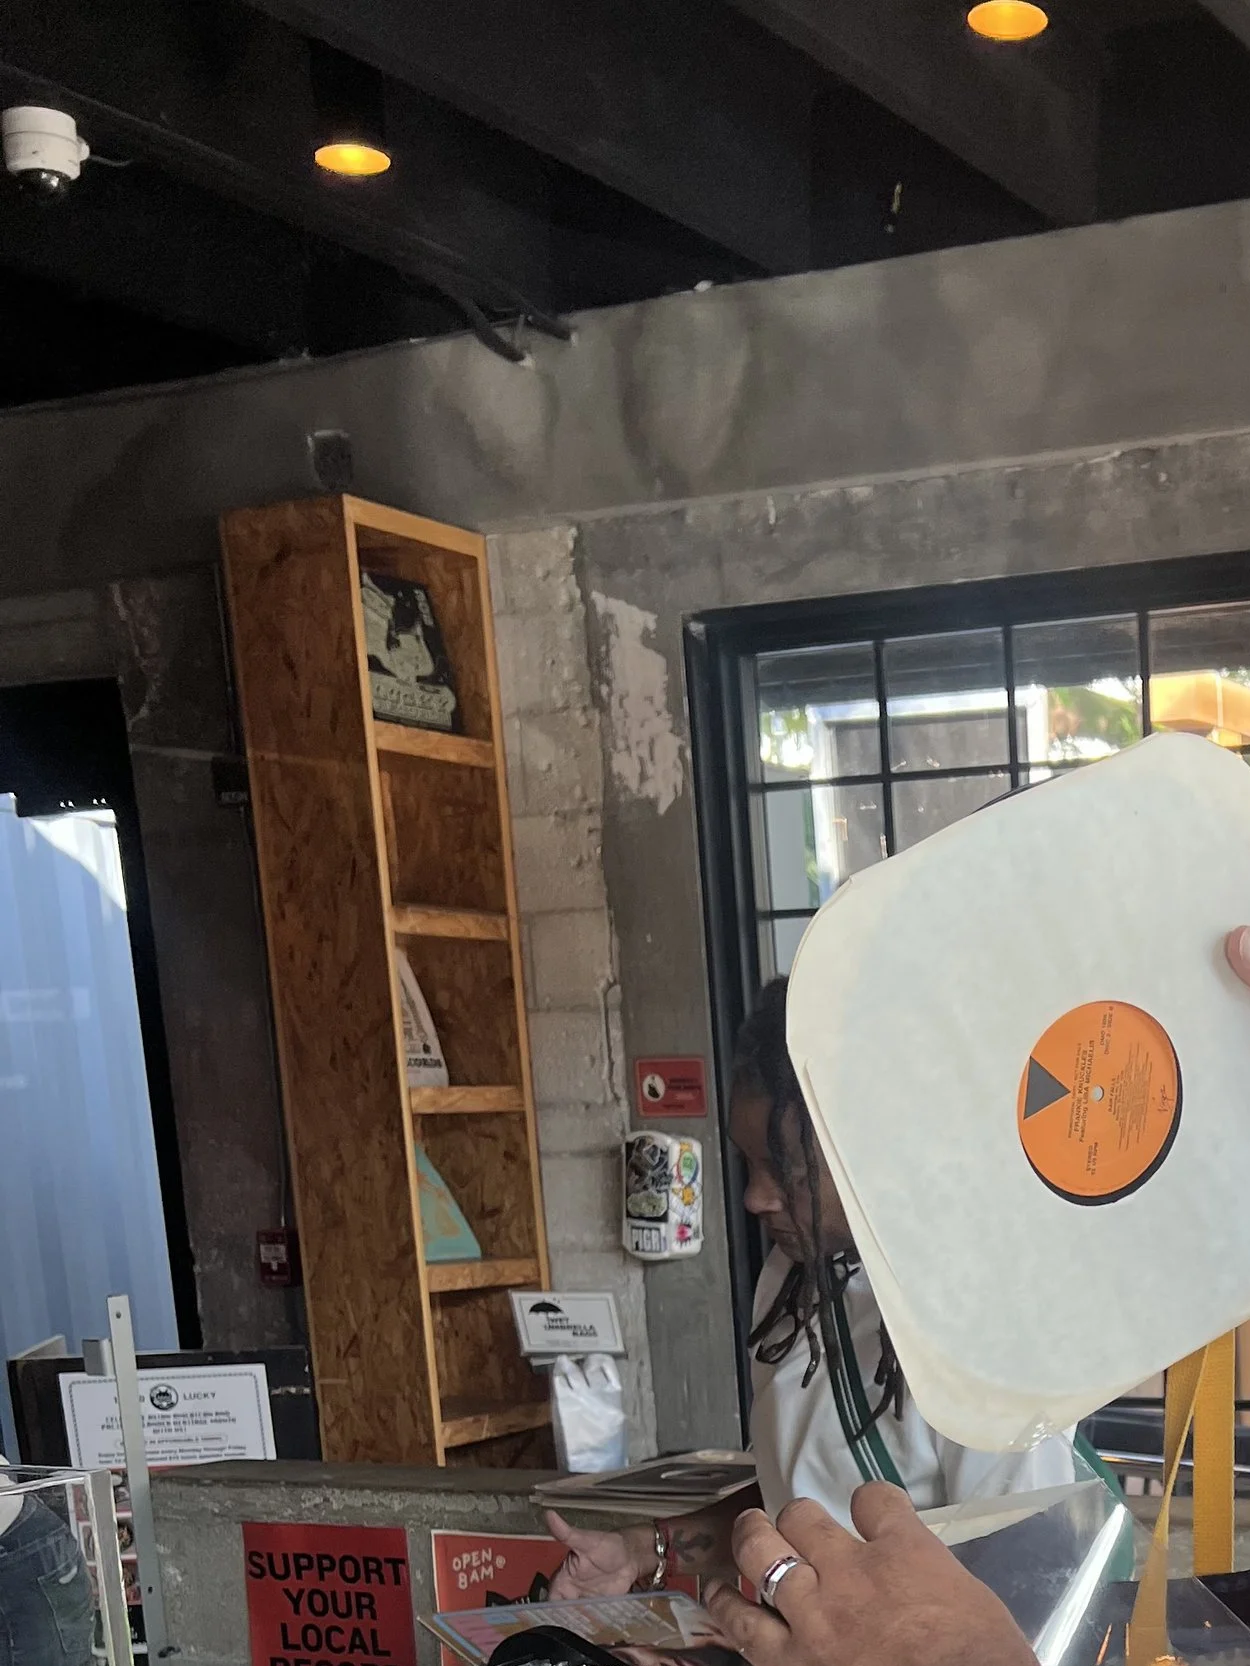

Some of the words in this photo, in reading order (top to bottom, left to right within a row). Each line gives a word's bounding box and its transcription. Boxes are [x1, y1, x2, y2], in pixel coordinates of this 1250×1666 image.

[183, 1392, 217, 1401] LUCKY
[248, 1551, 406, 1586] SUPPORT
[452, 1548, 493, 1572] OPEN
[458, 1566, 494, 1590] 8AM
[283, 1588, 378, 1621] YOUR
[280, 1622, 391, 1657] LOCAL
